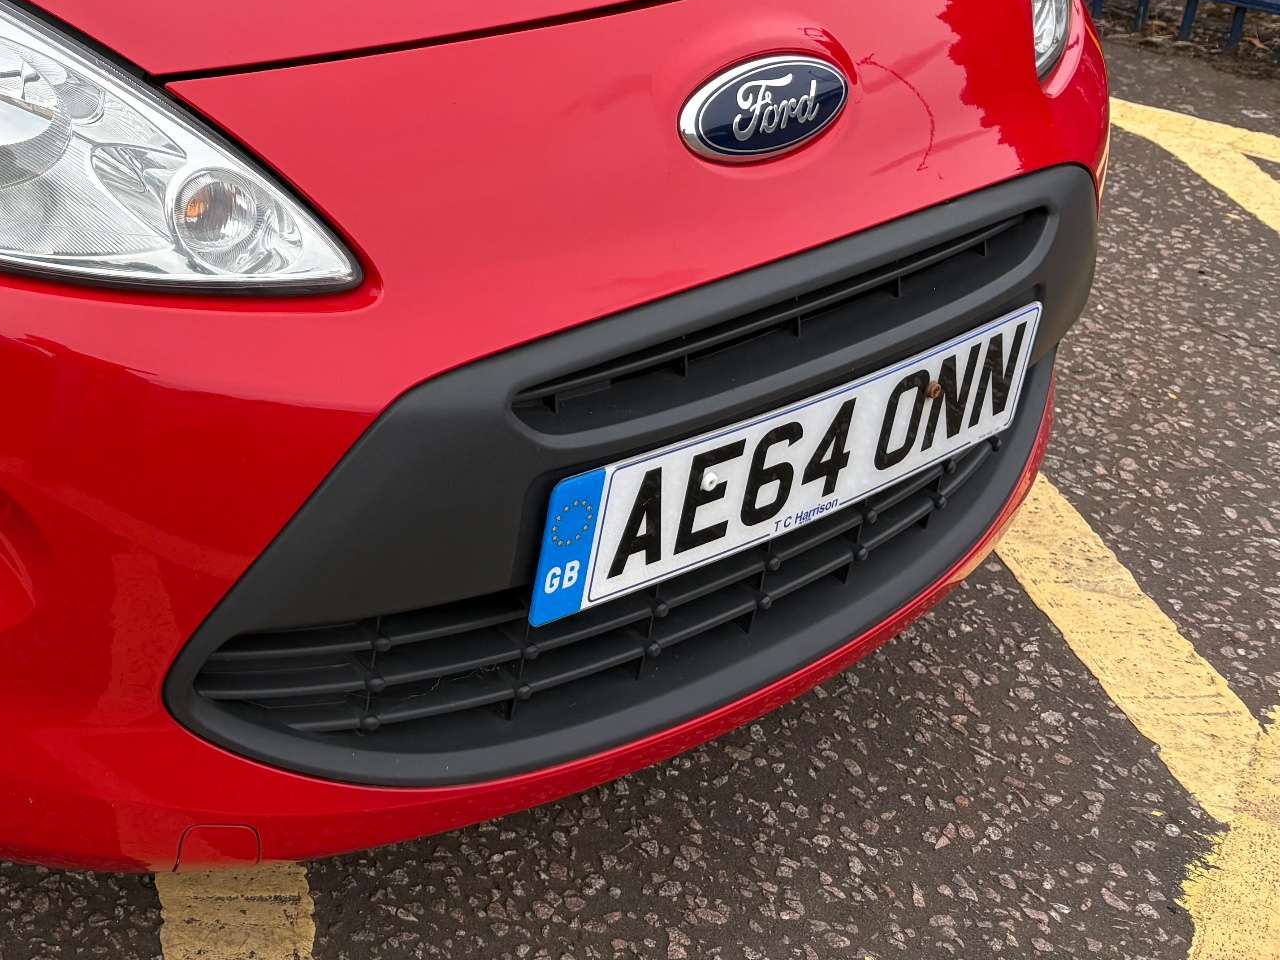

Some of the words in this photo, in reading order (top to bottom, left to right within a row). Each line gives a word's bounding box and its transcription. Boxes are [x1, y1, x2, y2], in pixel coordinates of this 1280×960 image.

[732, 73, 819, 141] Ford
[606, 397, 857, 580] AE64
[874, 321, 1027, 470] ONN
[774, 520, 782, 532] T
[783, 515, 792, 528] C
[794, 498, 839, 525] Harrison
[544, 560, 580, 594] GB
